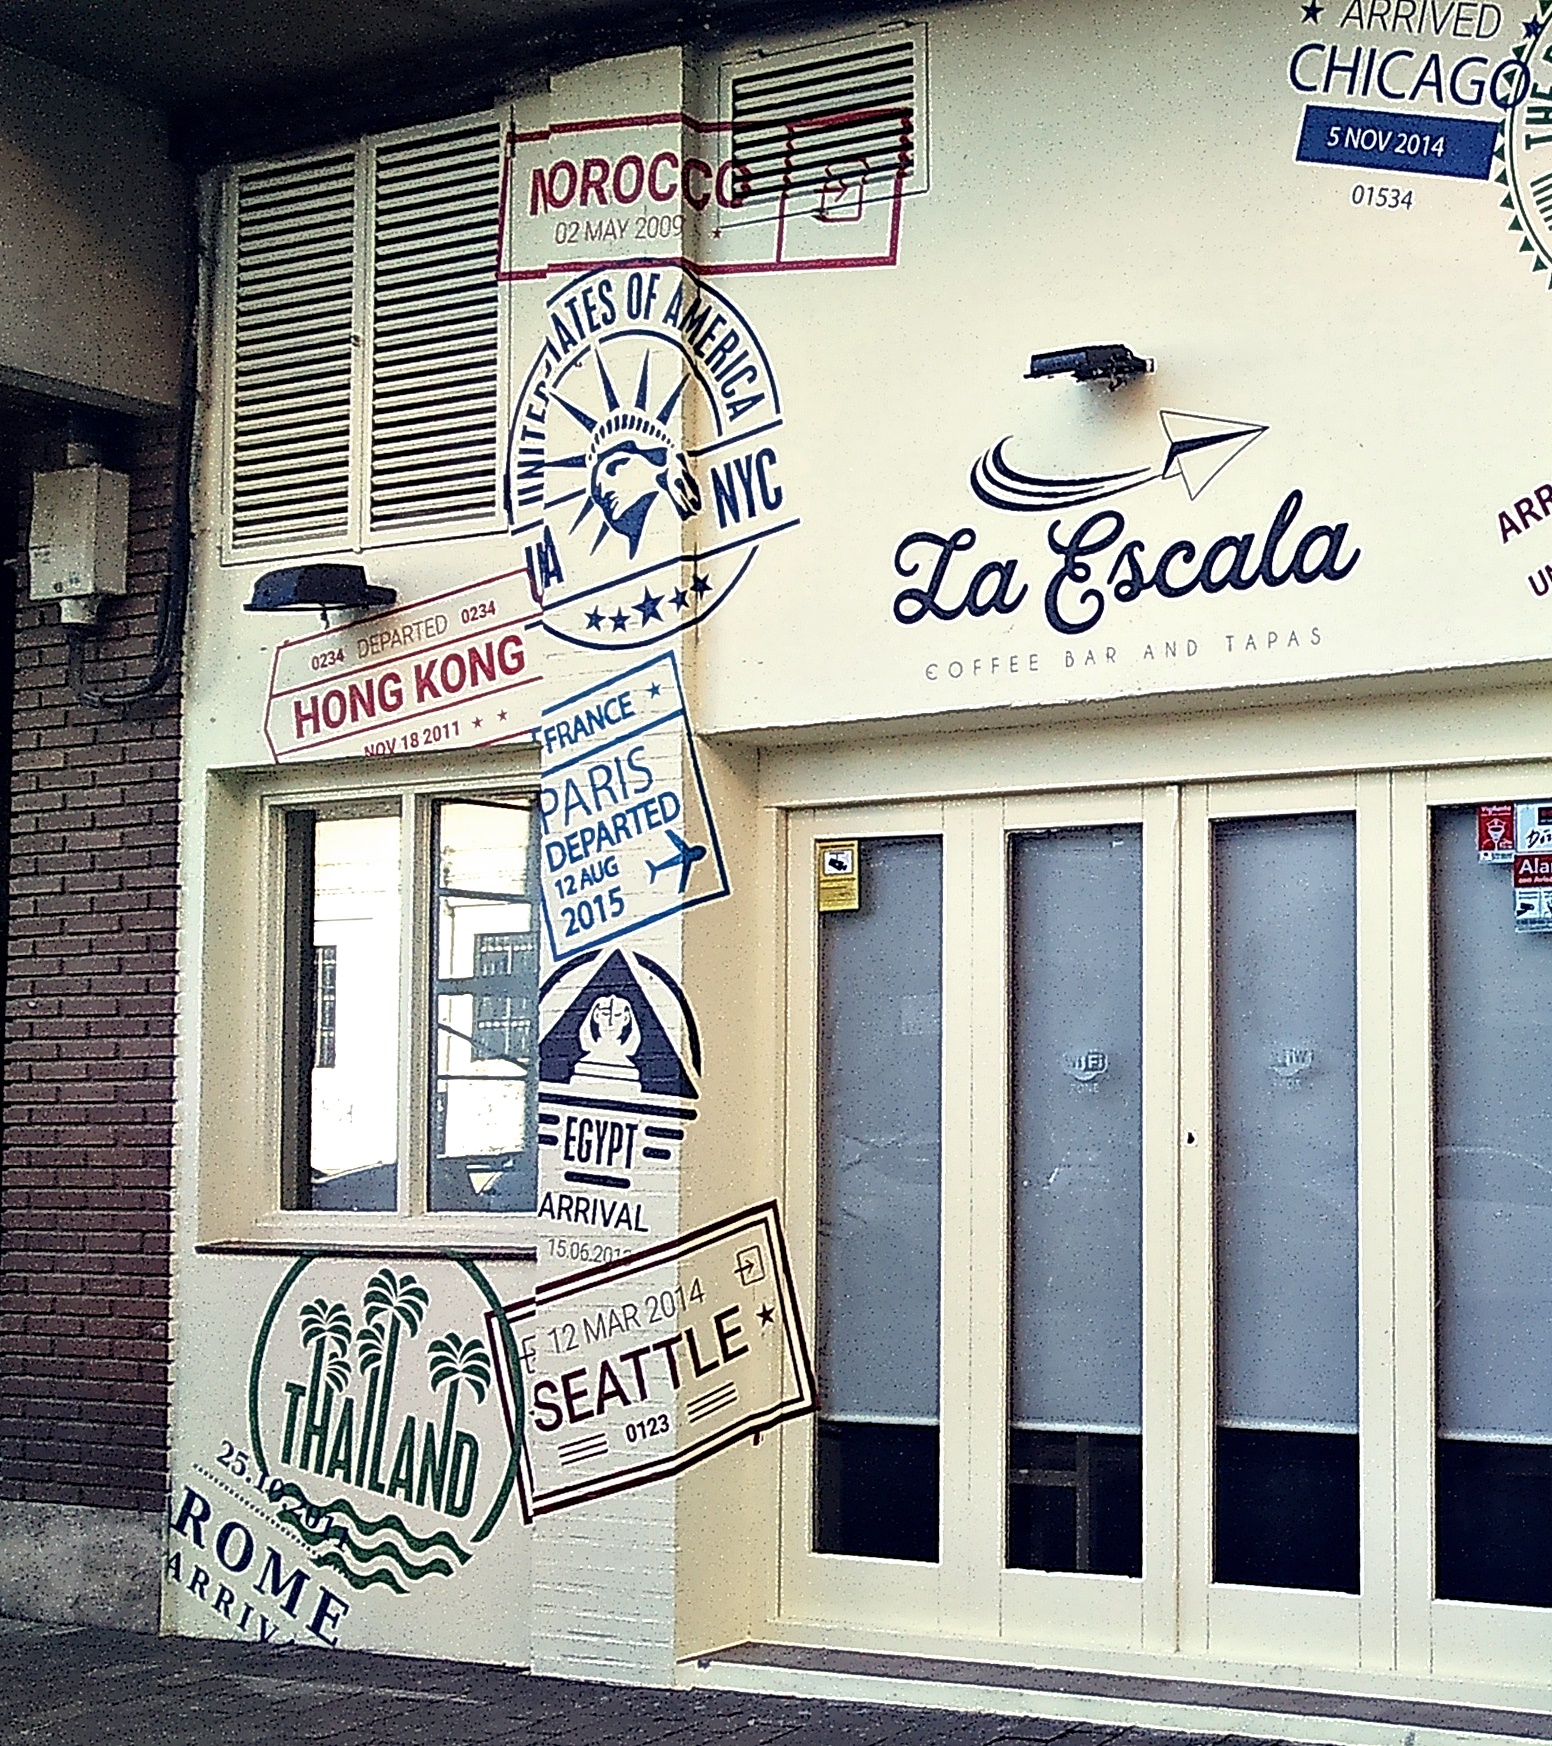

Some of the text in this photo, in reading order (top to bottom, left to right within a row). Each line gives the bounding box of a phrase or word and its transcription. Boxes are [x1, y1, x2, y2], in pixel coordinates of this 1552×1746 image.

[1340, 0, 1501, 39] ARRIVED
[1290, 43, 1531, 109] CHICAGO
[1327, 126, 1445, 157] 5 NOV 2014
[556, 214, 684, 244] 02 MAY 2009
[1352, 184, 1414, 210] 01534
[627, 272, 661, 320] OF
[662, 282, 766, 421] AMERICA
[711, 447, 783, 528] NYC
[893, 489, 1362, 635] La Escala
[311, 599, 496, 671] 0234 DEPARTED 0234
[925, 626, 1324, 682] COFFEE BAR AND TAPAS
[293, 634, 526, 739] HONG KONG
[364, 720, 461, 758] NOV 18 2011
[543, 691, 636, 754] FRANCE
[541, 745, 654, 835] PARIS
[545, 790, 681, 873] DEPARTED
[554, 855, 620, 899] 12 AUG
[560, 886, 625, 938] 2015
[563, 1115, 639, 1169] EGYPT
[538, 1191, 649, 1232] ARRIVAL
[548, 1277, 706, 1354] 12 MAR 2014
[533, 1305, 750, 1432] SEATTLE
[280, 1378, 481, 1519] THAILAND
[625, 1414, 670, 1444] 0123
[168, 1551, 295, 1645] ARRIV
[170, 1485, 350, 1647] ROME
